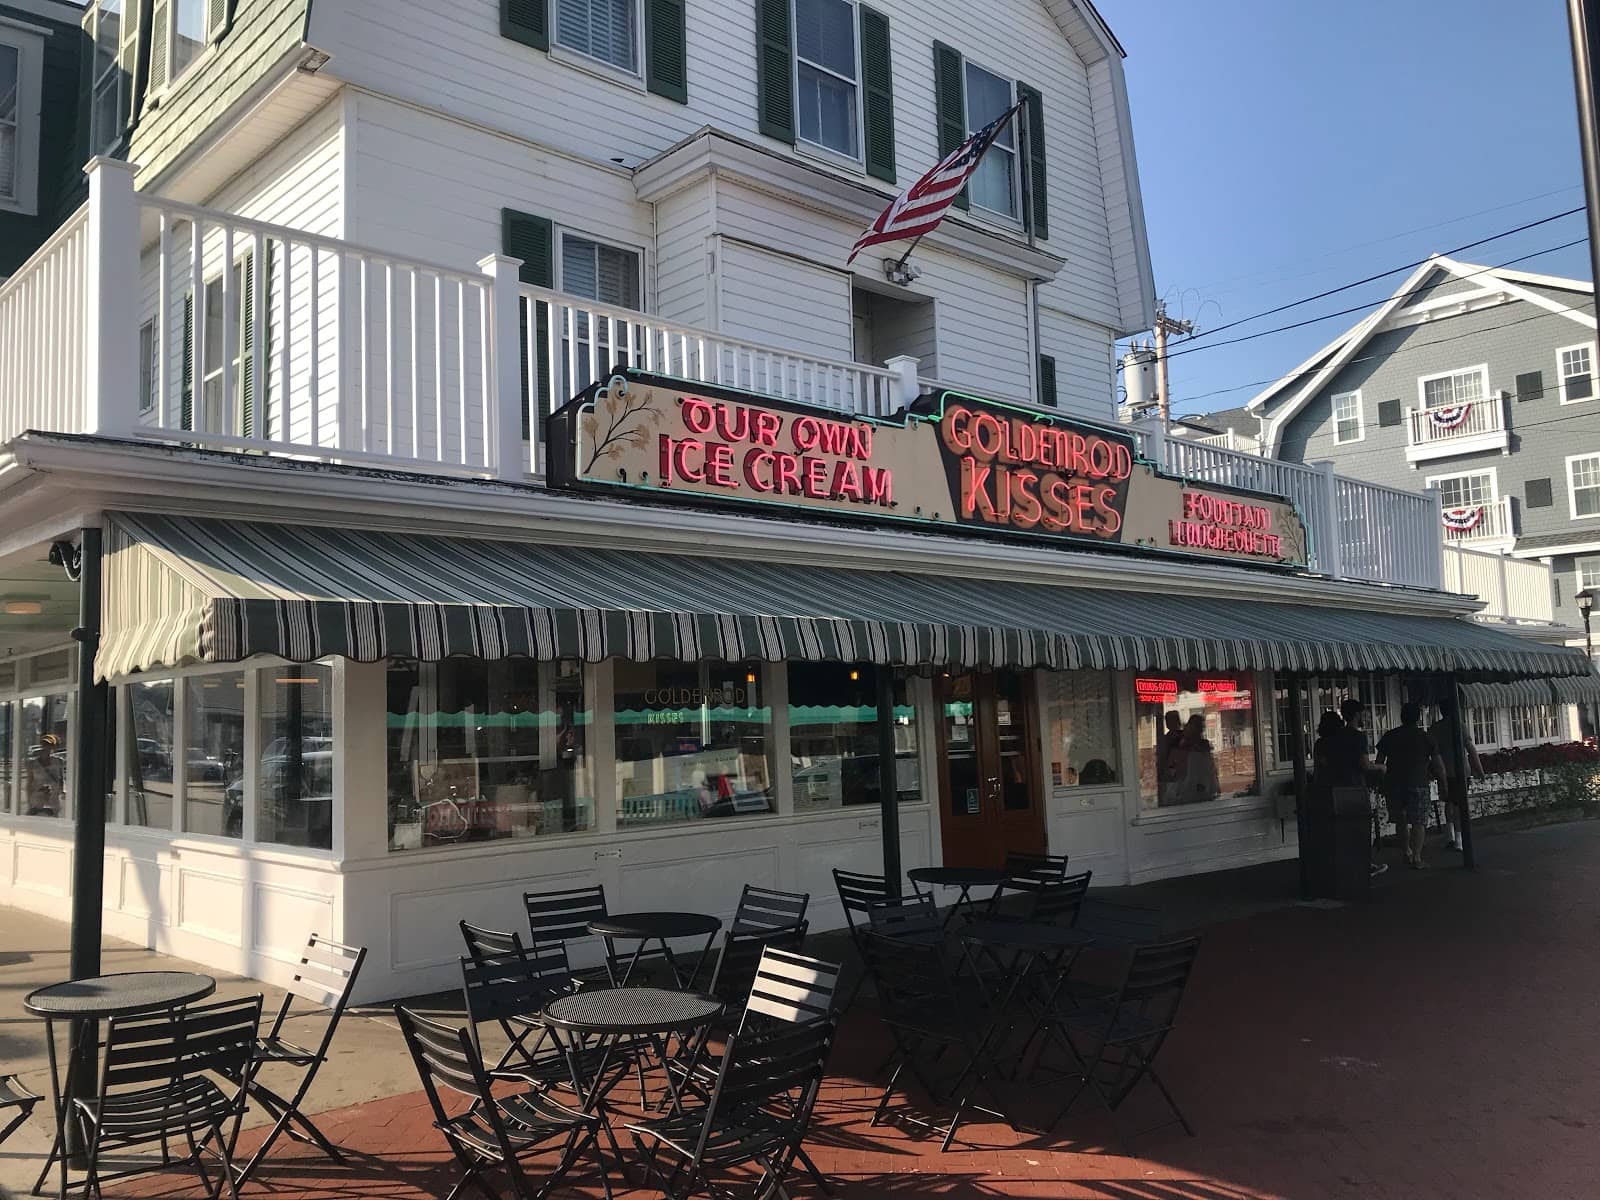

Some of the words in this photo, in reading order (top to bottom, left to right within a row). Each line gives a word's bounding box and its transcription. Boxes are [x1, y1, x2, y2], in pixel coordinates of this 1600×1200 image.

[681, 398, 784, 447] OUR
[790, 417, 873, 461] OWN
[941, 403, 1132, 483] GOLDENROD
[658, 433, 740, 489] ICE
[743, 447, 894, 508] CREAM
[960, 456, 1122, 539] KISSES
[1182, 491, 1272, 531] FOUNTAIN
[644, 687, 746, 705] GOLDENROD
